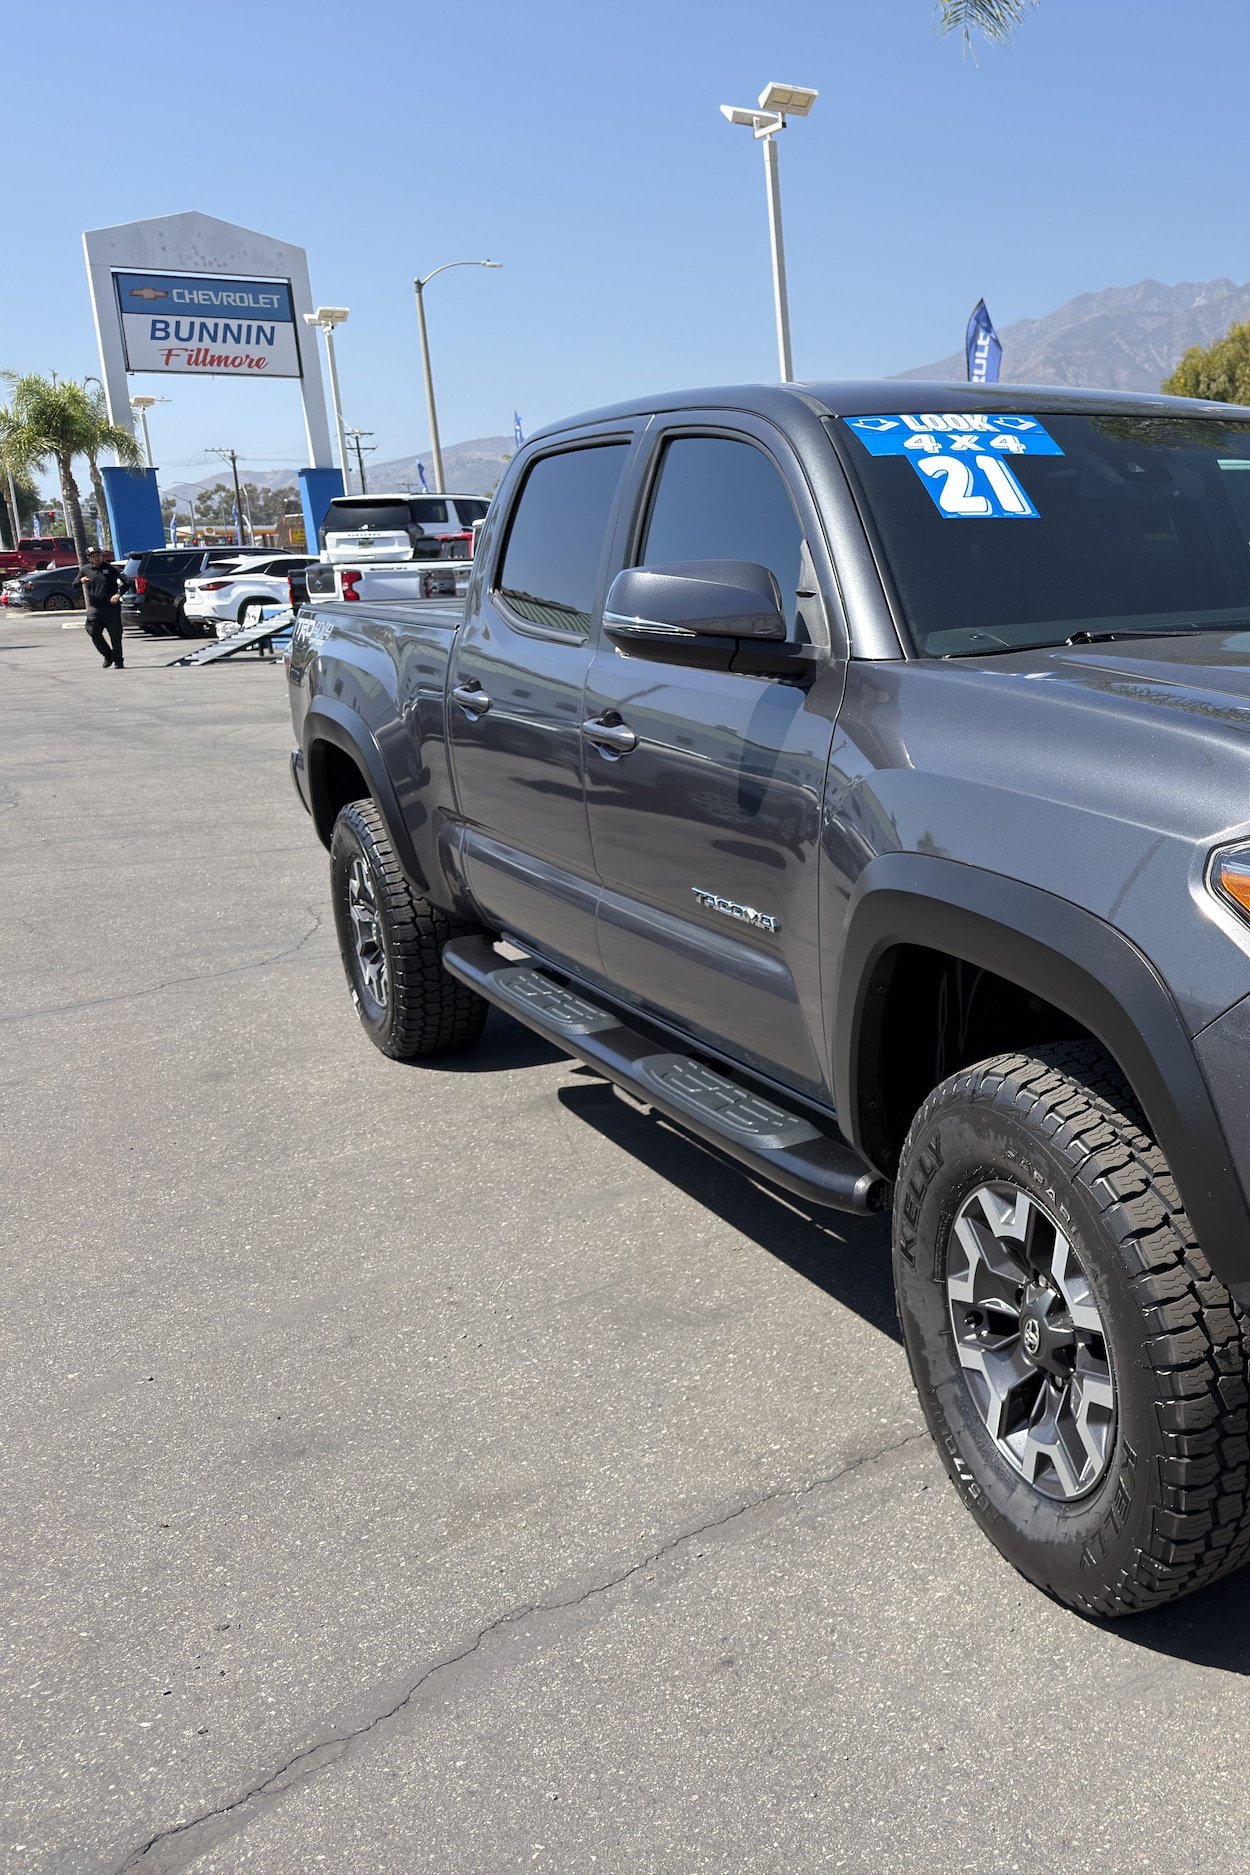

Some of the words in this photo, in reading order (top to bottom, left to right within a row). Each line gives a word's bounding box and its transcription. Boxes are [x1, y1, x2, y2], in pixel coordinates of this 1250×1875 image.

[172, 288, 280, 308] CHEVROLET
[150, 319, 276, 346] BUNNIN
[158, 347, 269, 370] Fillmore
[900, 414, 1001, 432] LOOK
[917, 455, 1033, 515] 21
[691, 887, 779, 933] TACOMA
[900, 1133, 945, 1269] KELLY
